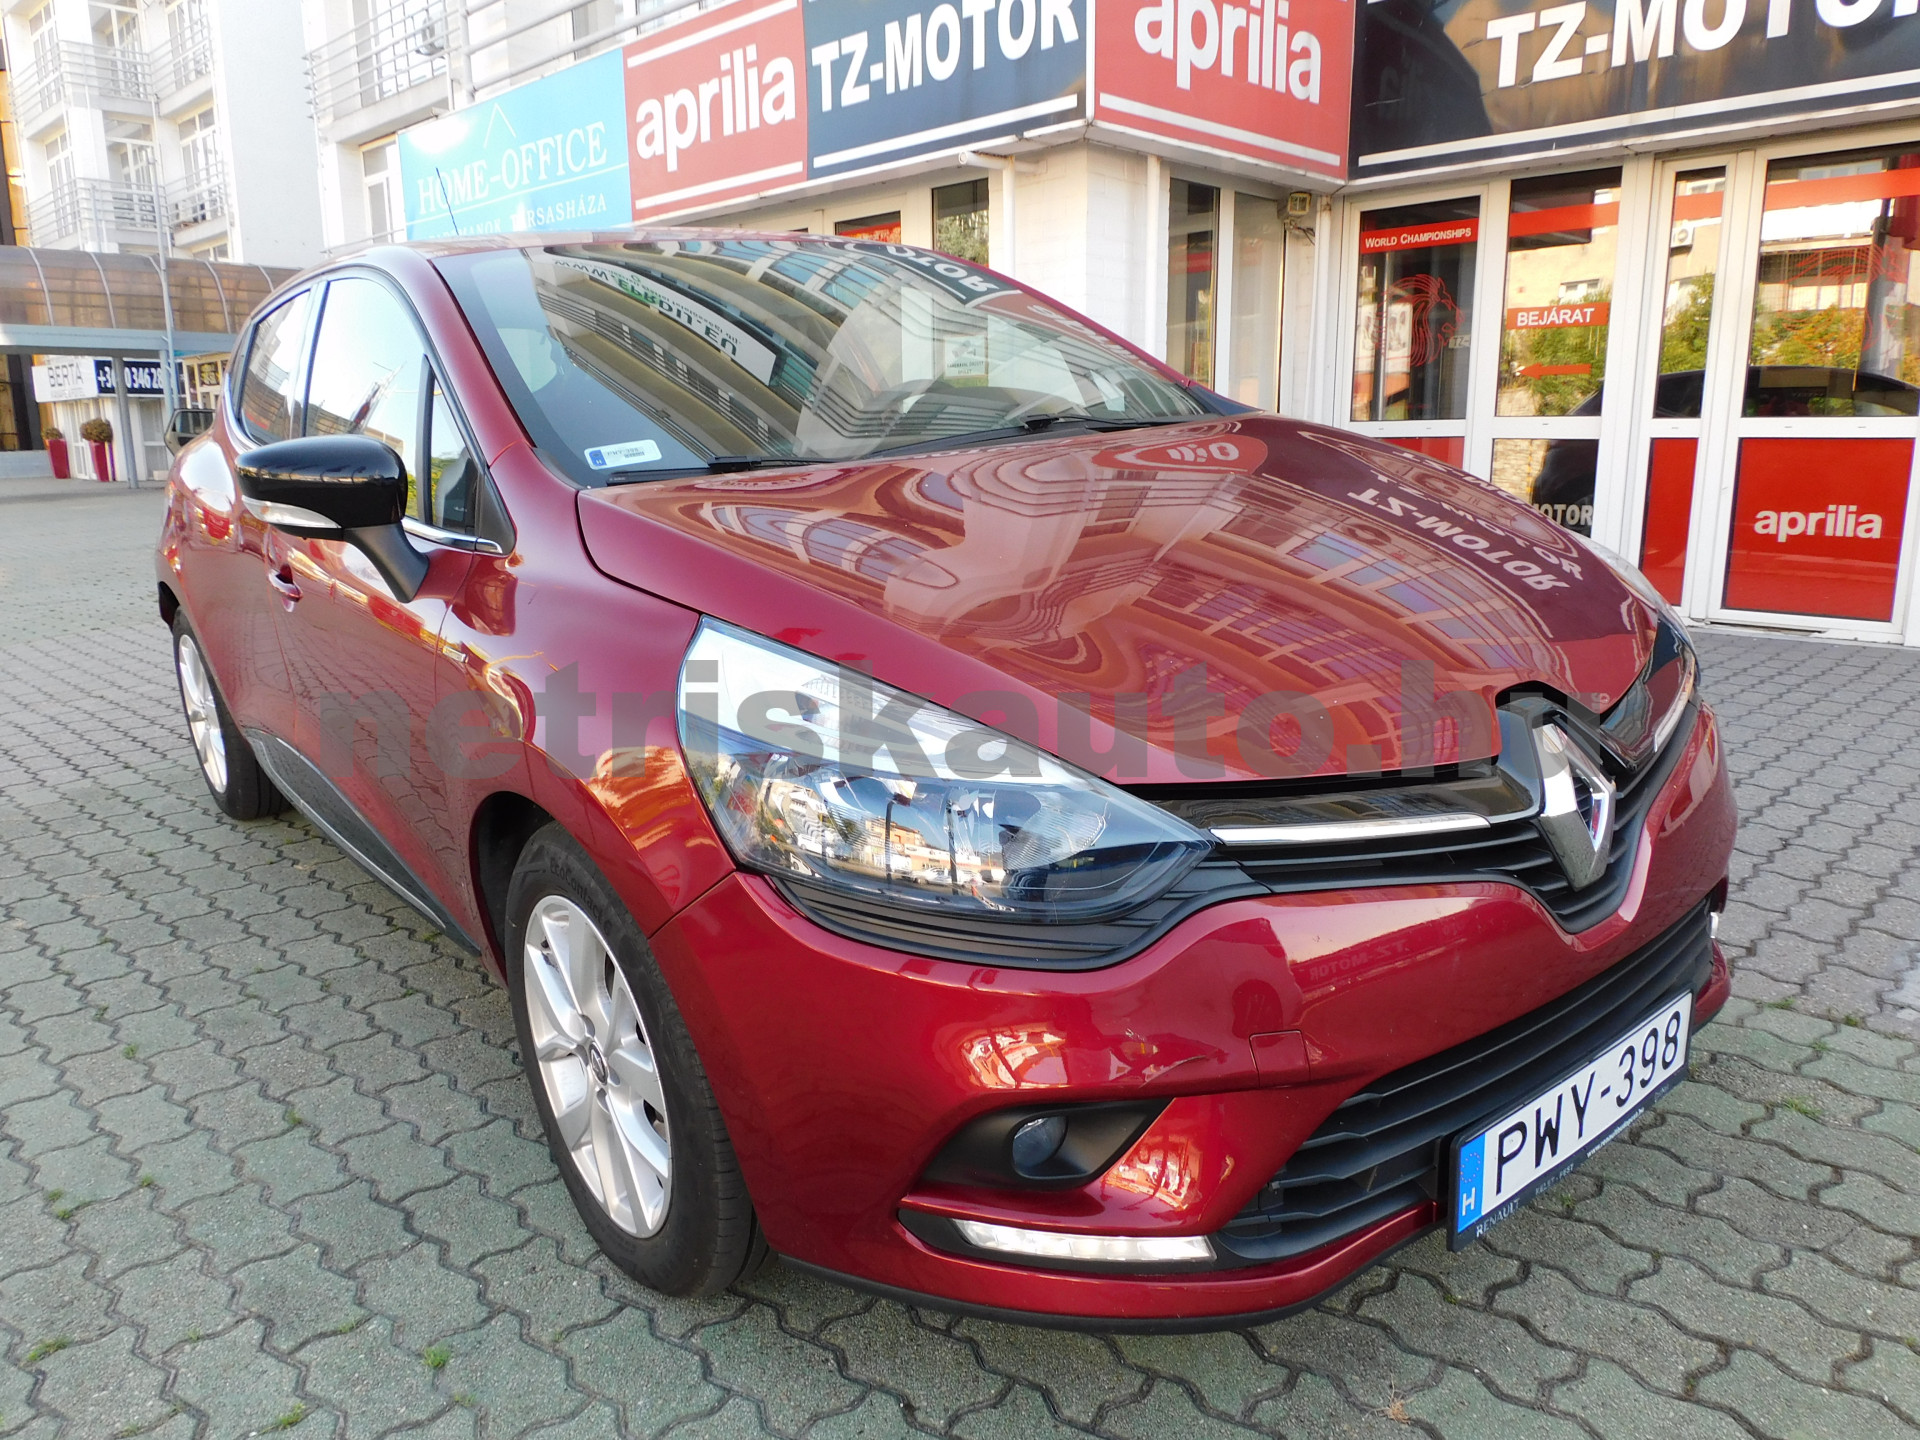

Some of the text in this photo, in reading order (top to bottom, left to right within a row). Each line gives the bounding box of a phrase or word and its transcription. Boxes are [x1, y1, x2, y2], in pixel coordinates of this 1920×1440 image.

[811, 0, 1079, 112] TZ-MOTOR
[1134, 0, 1322, 104] aprilia
[1486, 0, 1920, 88] TZ-MOT
[636, 44, 796, 172] aprilia
[417, 121, 608, 215] HOME-OFFICE
[1365, 227, 1472, 249] WORLD CHAMPIONSHIPS
[1516, 307, 1596, 327] BEJÁRAT
[47, 362, 84, 388] BERTA
[1532, 503, 1594, 526] OTOR
[1753, 504, 1883, 543] aprilia
[1495, 1009, 1682, 1197] PWY-398
[1461, 1186, 1476, 1217] H
[1476, 1198, 1520, 1238] RENAULT
